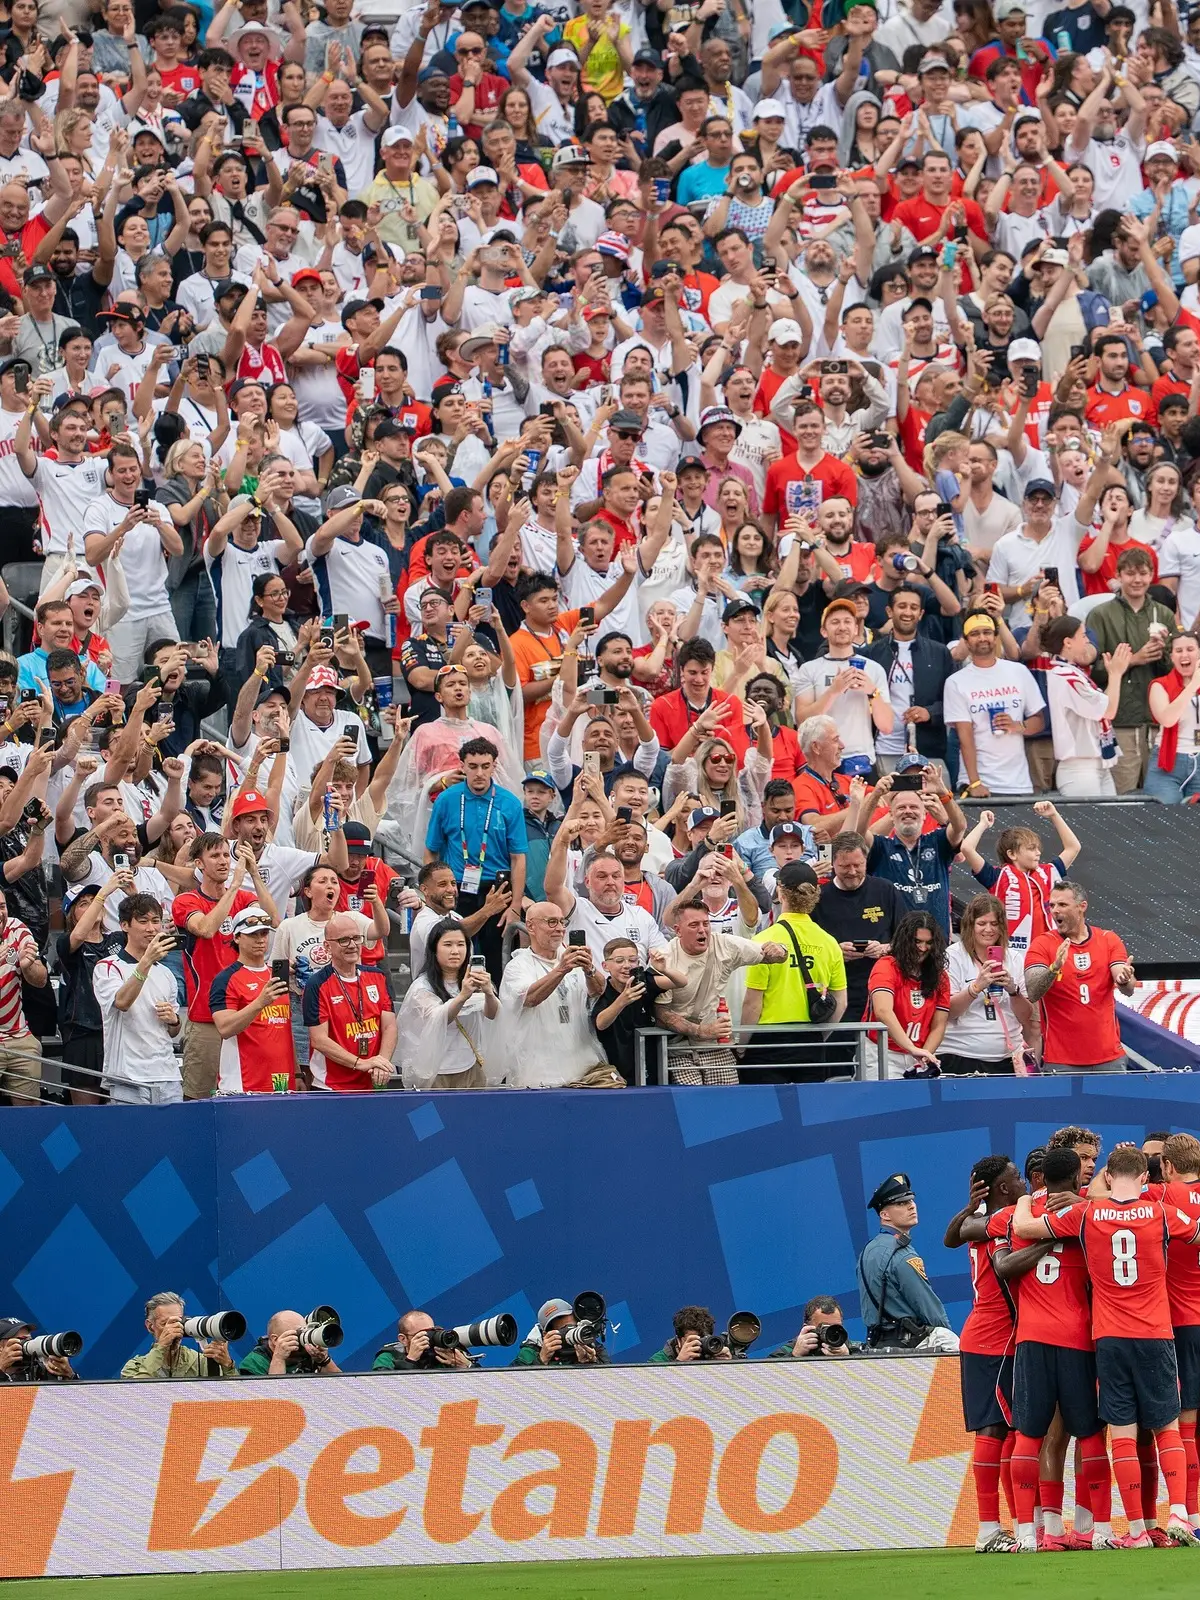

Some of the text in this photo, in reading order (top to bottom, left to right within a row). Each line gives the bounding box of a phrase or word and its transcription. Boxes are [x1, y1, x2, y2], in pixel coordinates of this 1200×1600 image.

[128, 382, 142, 400] 1
[971, 686, 1020, 699] PANAMA
[893, 882, 941, 893] Snapgon
[296, 937, 322, 953] ENGL
[790, 954, 815, 969] 16
[1079, 984, 1089, 1004] 9
[1093, 1206, 1154, 1221] ANDERSON
[1112, 1228, 1139, 1286] 8
[147, 1398, 840, 1552] Betano
